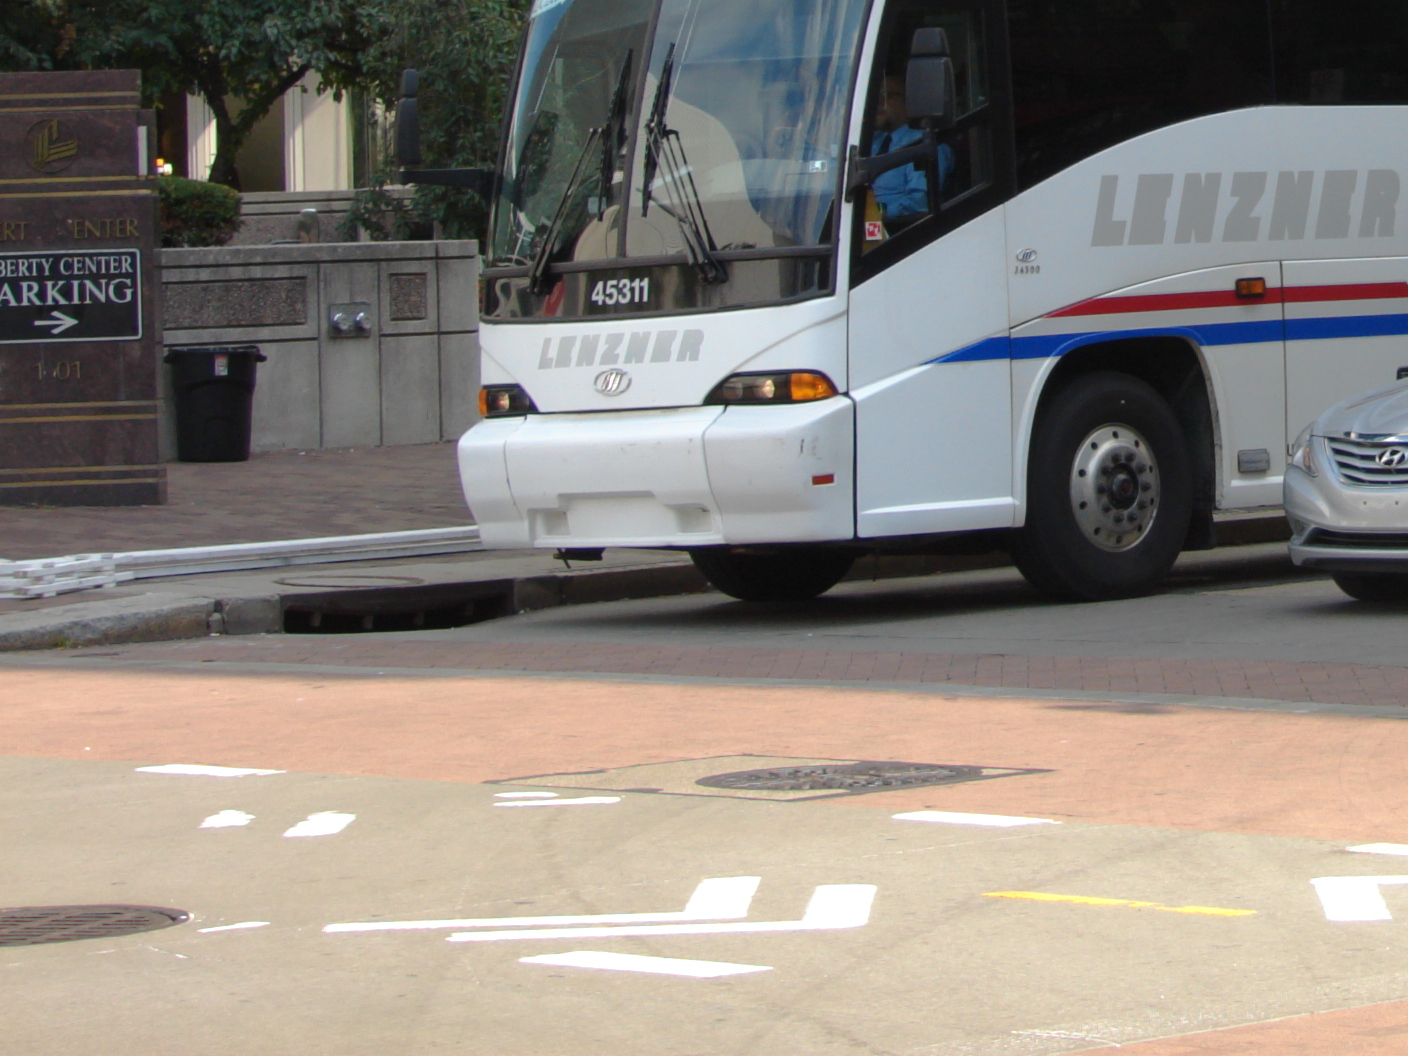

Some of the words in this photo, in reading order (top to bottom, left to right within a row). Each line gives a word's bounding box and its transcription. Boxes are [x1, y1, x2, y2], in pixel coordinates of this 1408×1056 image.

[1091, 169, 1400, 247] LENZNER
[60, 255, 133, 275] CENTER
[0, 278, 134, 307] ARKING
[591, 277, 649, 305] 45311
[538, 329, 705, 370] LENZNER
